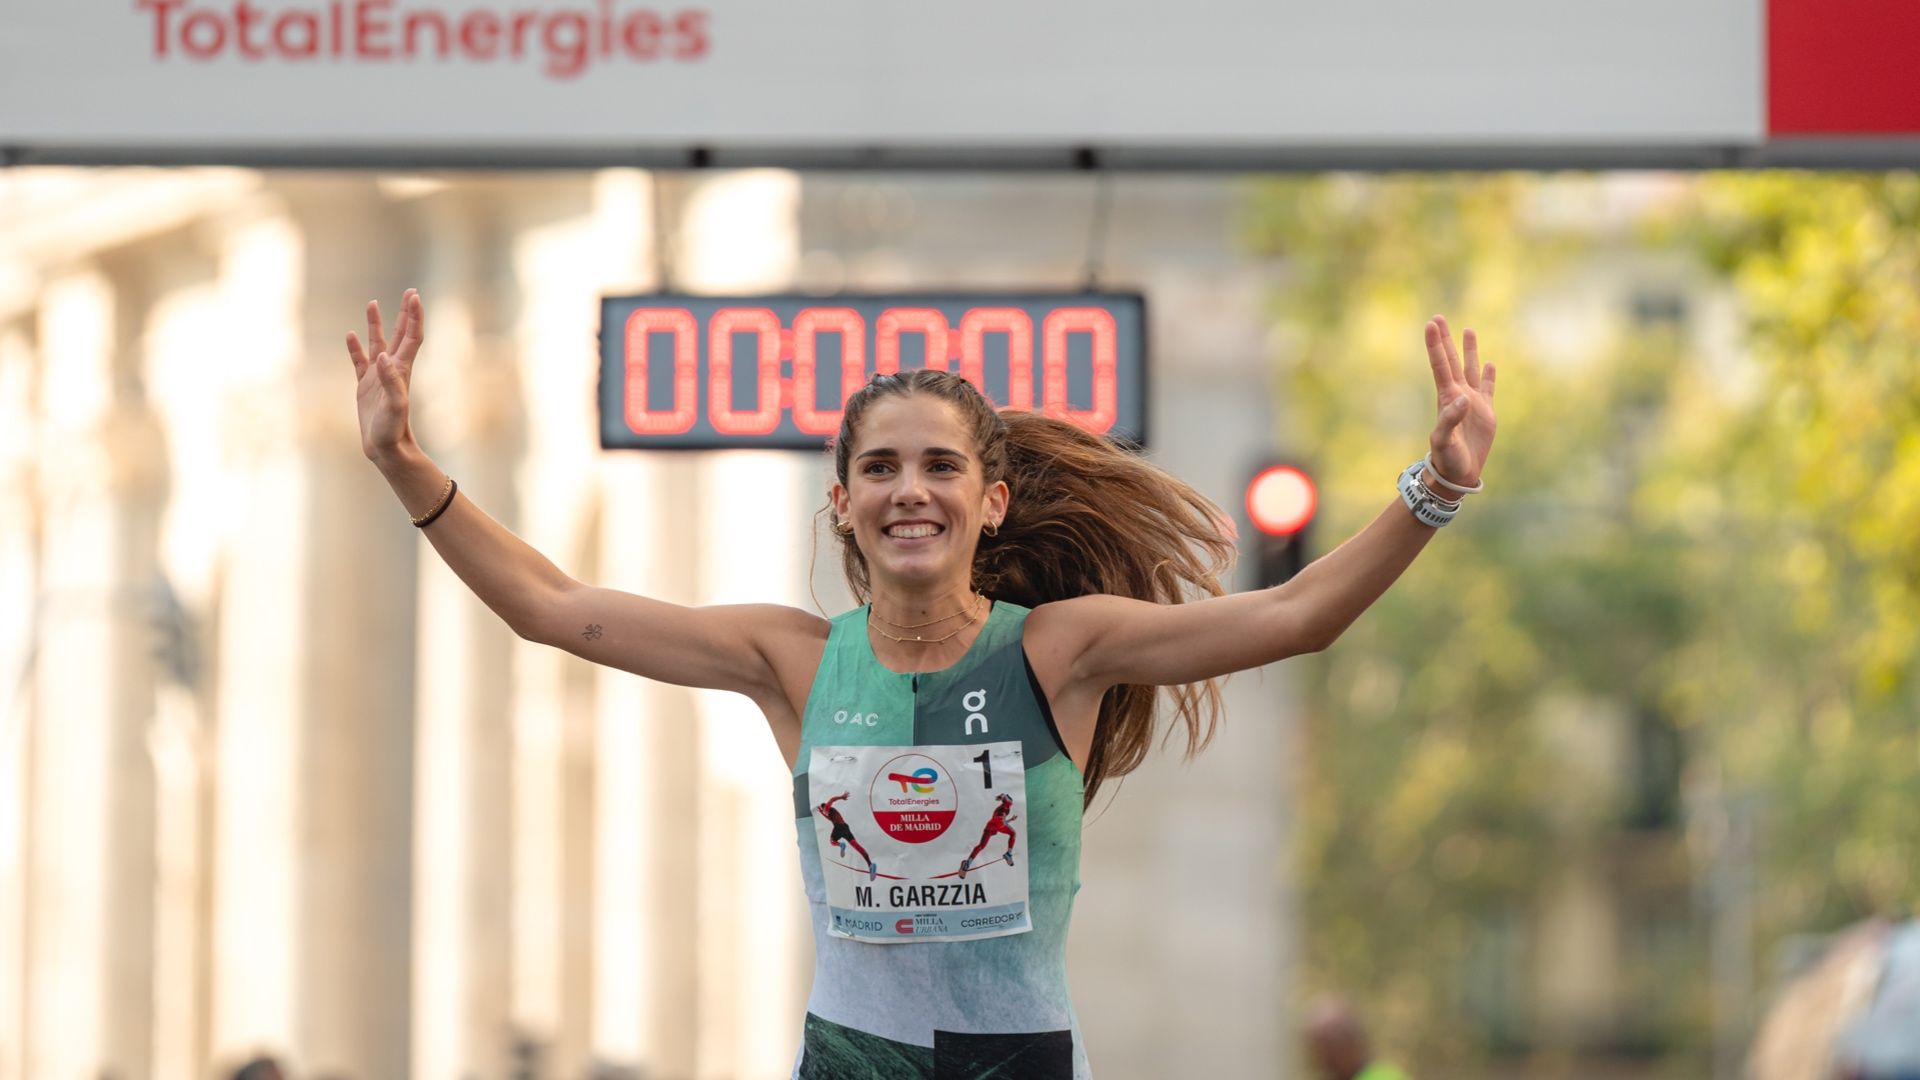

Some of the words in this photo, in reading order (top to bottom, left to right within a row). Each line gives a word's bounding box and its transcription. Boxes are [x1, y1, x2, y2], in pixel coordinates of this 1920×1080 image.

[133, 0, 712, 78] TotalEnergies
[833, 710, 879, 727] OAC
[973, 749, 993, 790] 1
[888, 798, 940, 807] TotalEnergies
[900, 814, 930, 822] MILLA
[890, 824, 903, 832] DE
[905, 823, 942, 831] MADRID
[855, 886, 880, 908] M.
[889, 883, 987, 908] GARZZIA
[845, 918, 883, 932] MADRID
[960, 913, 1015, 928] CORREDOR
